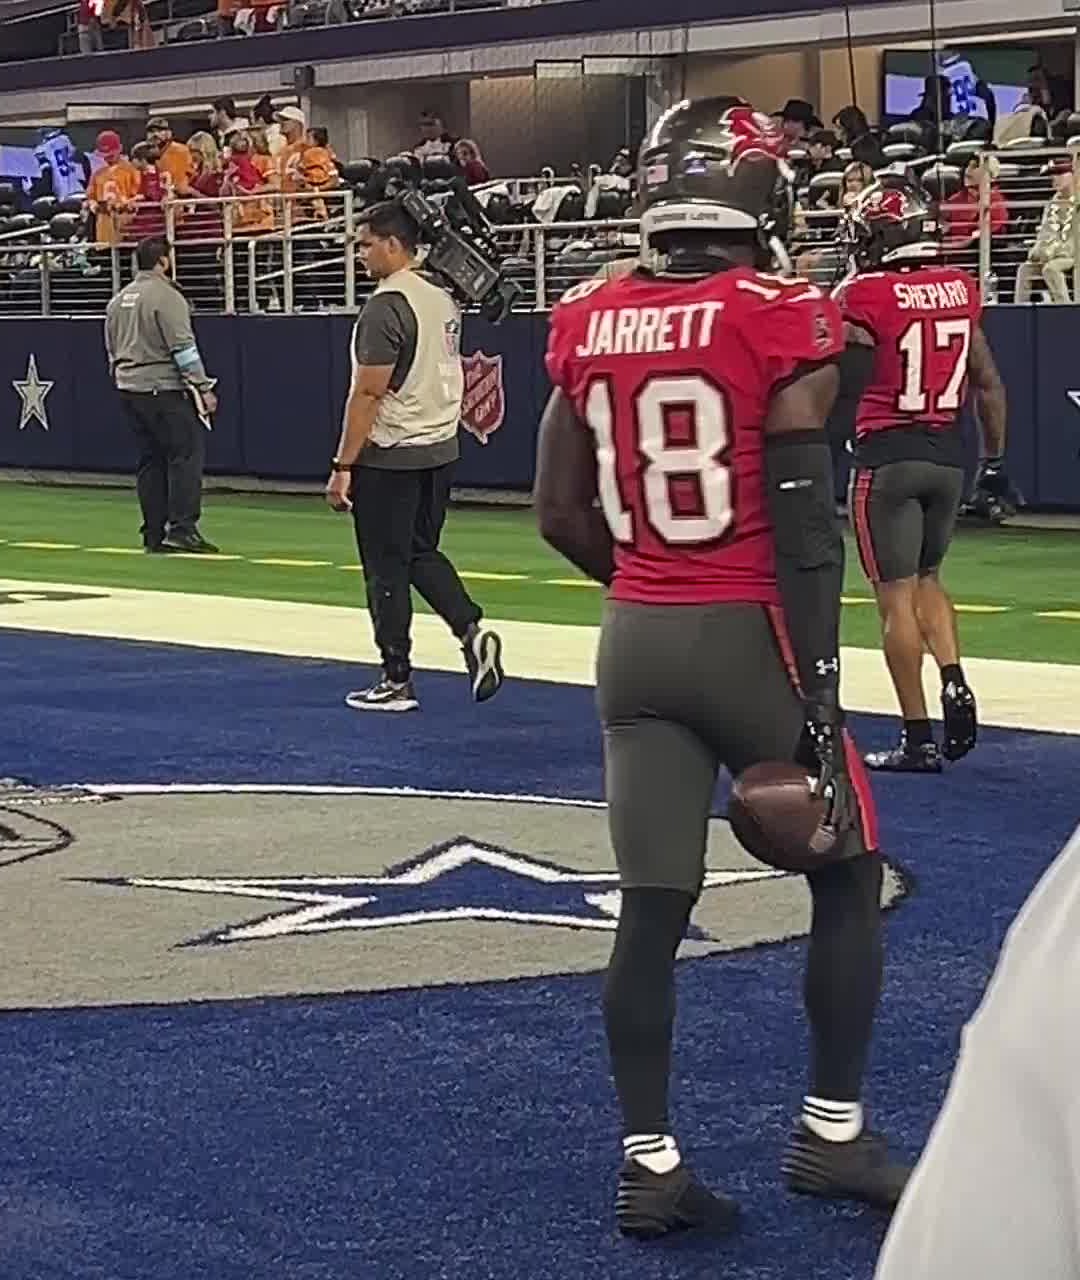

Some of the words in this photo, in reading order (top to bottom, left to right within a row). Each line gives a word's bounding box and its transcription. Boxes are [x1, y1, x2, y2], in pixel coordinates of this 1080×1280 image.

[576, 301, 725, 358] JARRETT
[893, 279, 969, 310] SHEPARD
[899, 318, 971, 411] 17
[584, 375, 734, 545] 18
